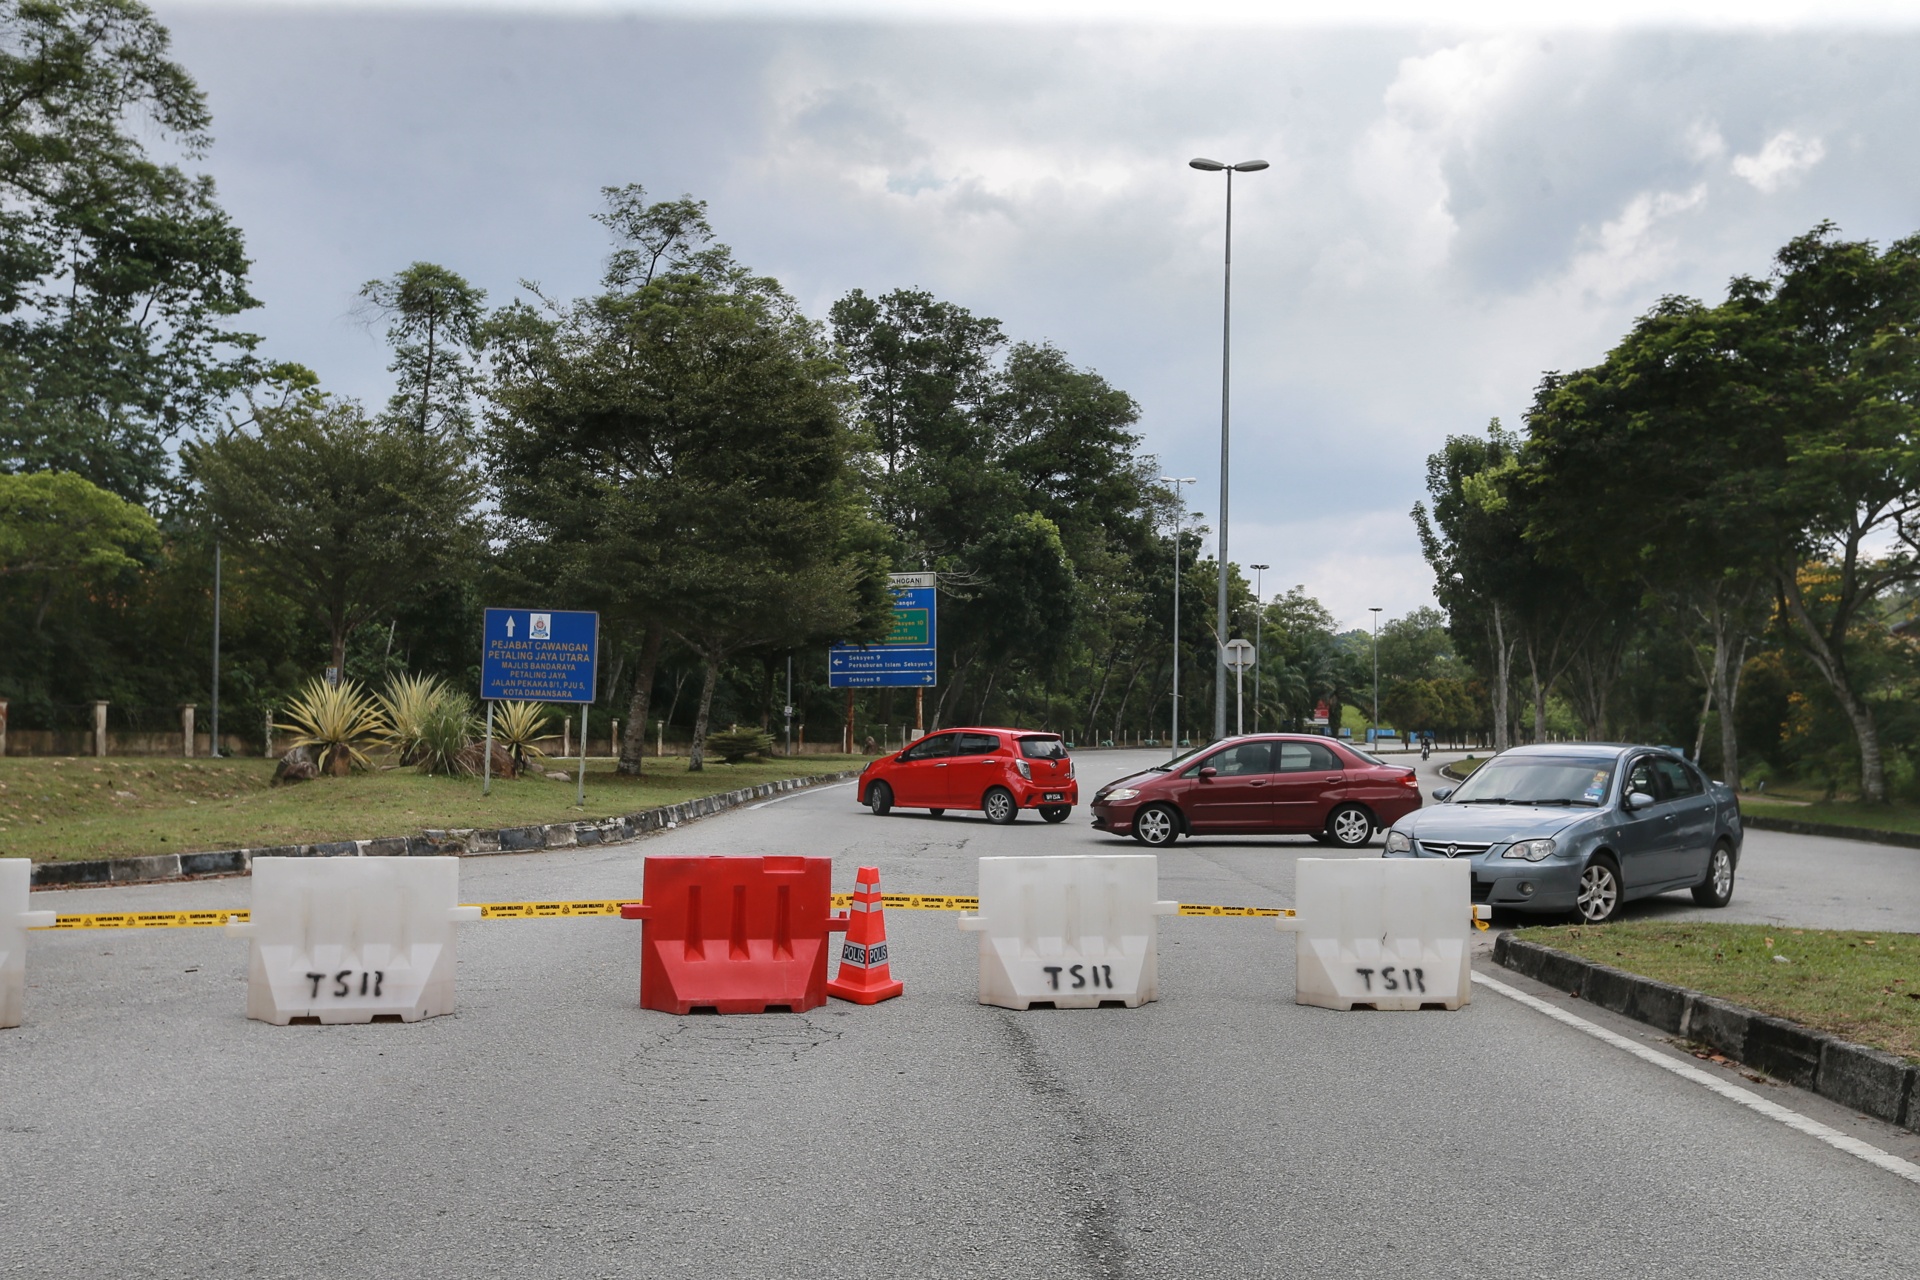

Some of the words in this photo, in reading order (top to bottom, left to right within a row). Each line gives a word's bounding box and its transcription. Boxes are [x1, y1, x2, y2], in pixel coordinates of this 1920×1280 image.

[492, 640, 532, 650] PEJABAT
[535, 642, 588, 652] CAWANGAN
[488, 650, 533, 660] PETALING
[535, 652, 557, 661] JAYA
[560, 653, 590, 662] UTARA
[530, 662, 576, 671] BANDARAYA
[525, 689, 572, 698] DAMANSARA
[843, 946, 865, 963] POLIS
[870, 946, 887, 963] POLIS
